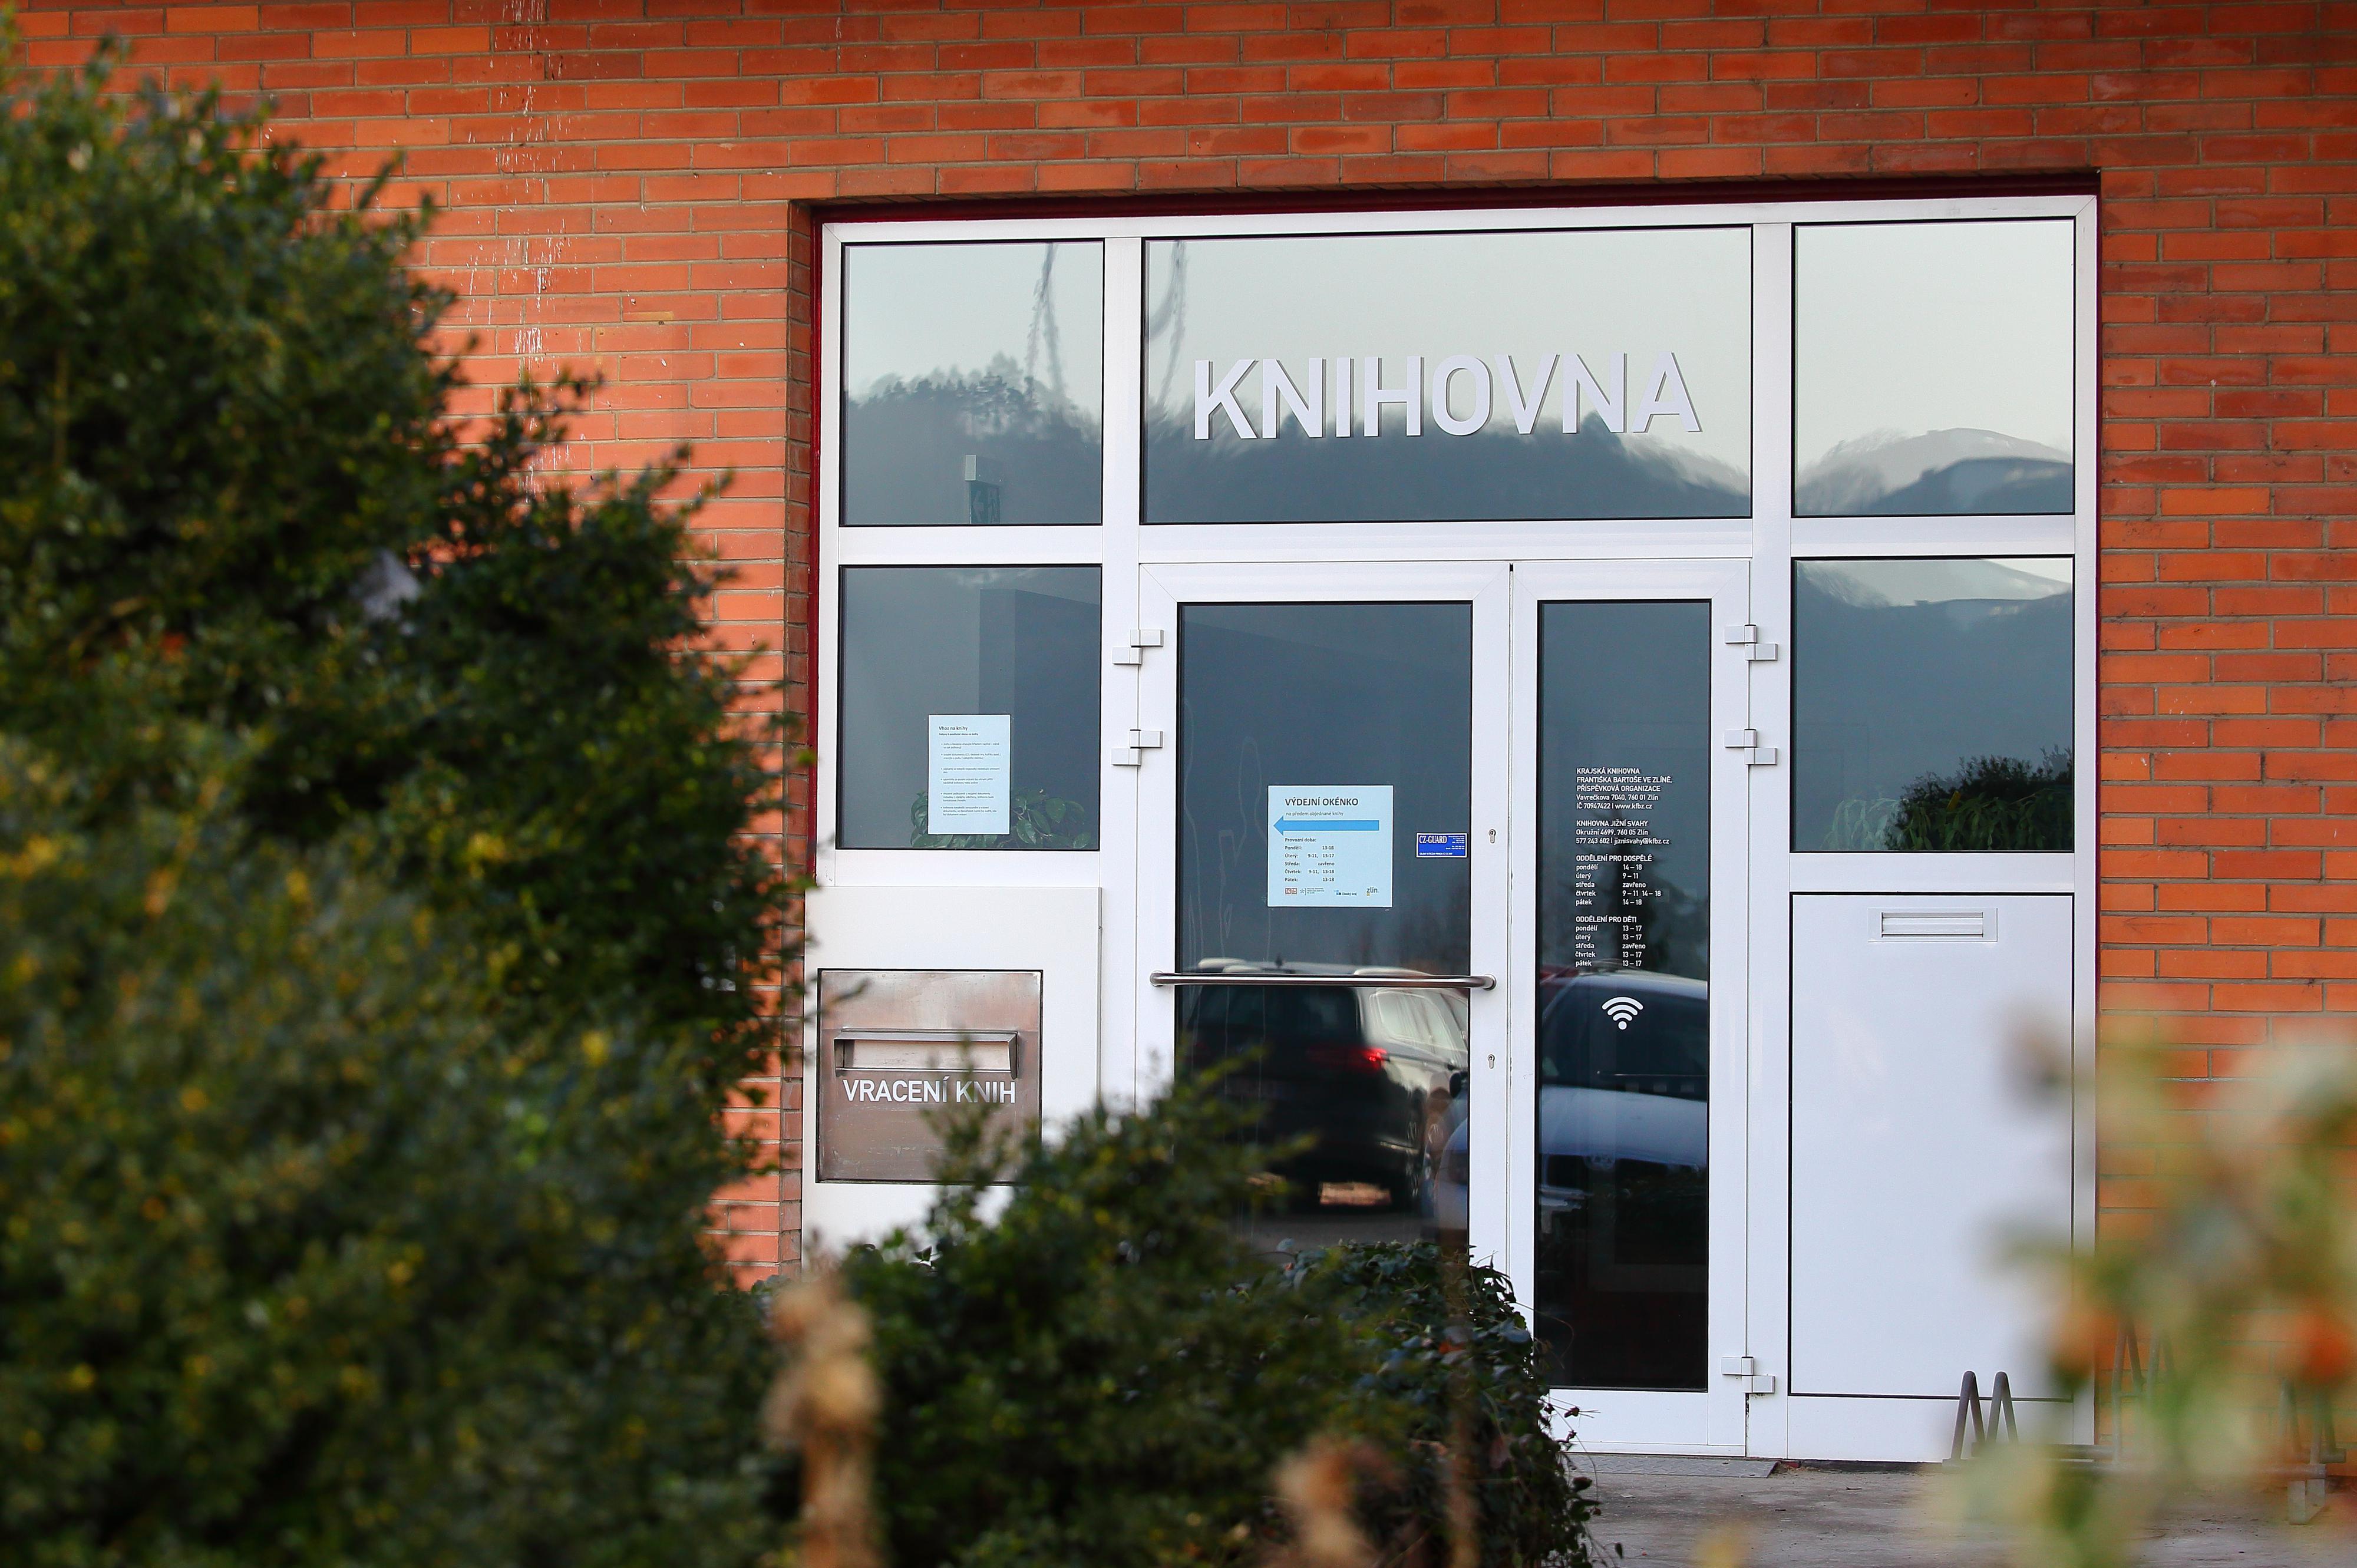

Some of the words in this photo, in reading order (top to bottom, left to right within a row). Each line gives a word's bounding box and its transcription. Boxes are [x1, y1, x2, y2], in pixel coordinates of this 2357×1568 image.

[1193, 352, 1702, 440] KNIHOVNA
[1285, 797, 1321, 806] VÝDEJNÍ
[1323, 797, 1358, 806] OKÉNKO
[843, 1075, 950, 1102] VRACENÍ
[956, 1081, 1015, 1103] KNIH
